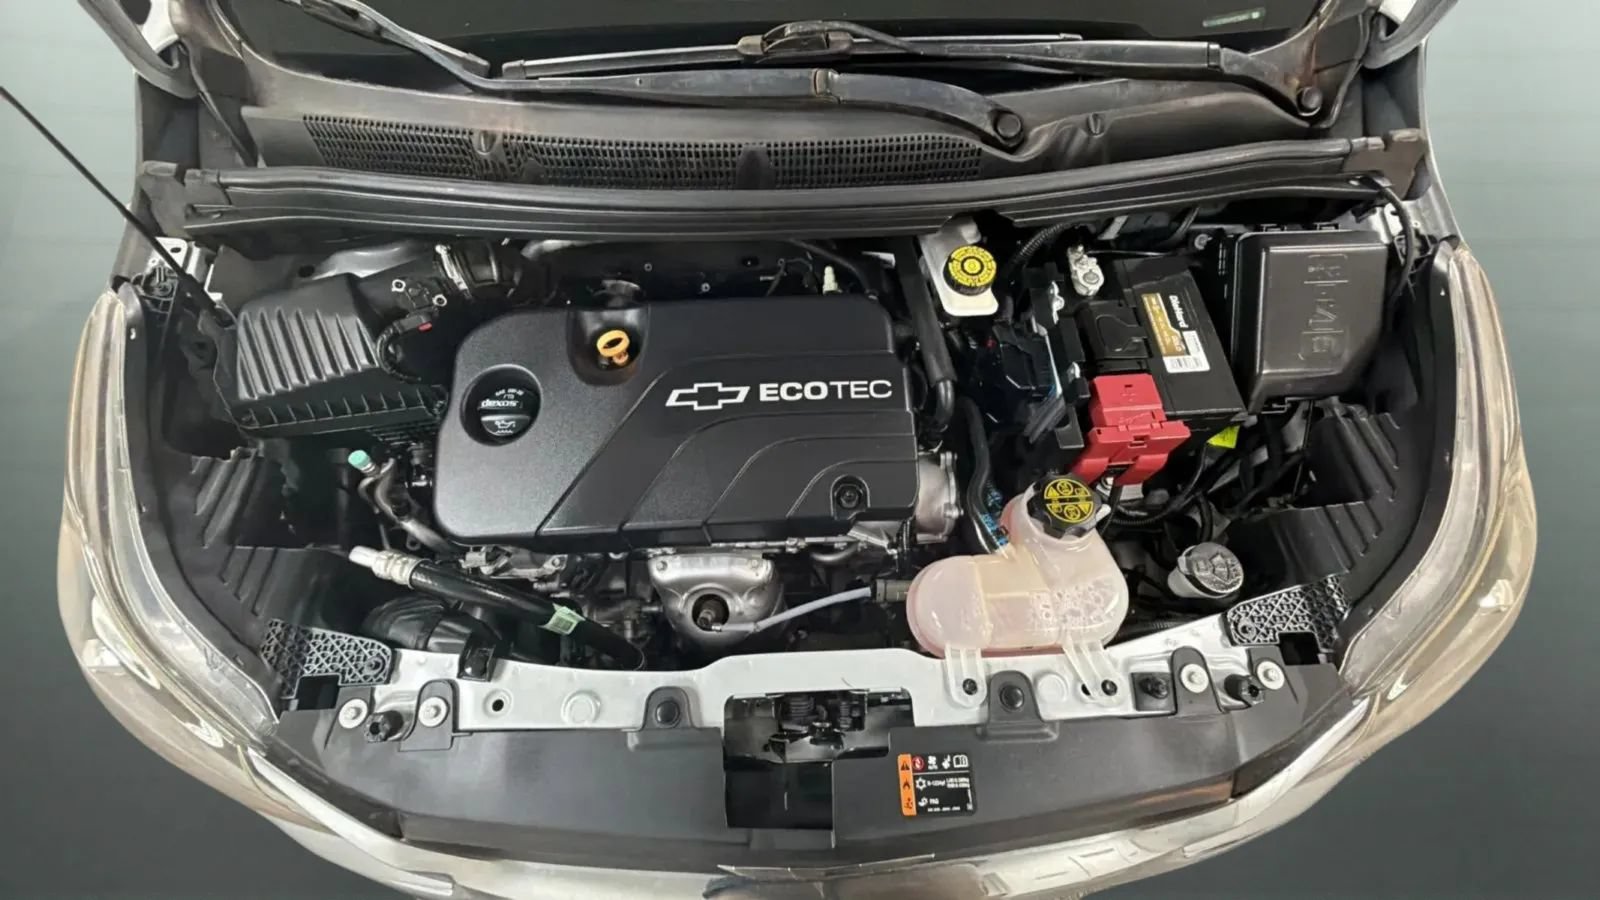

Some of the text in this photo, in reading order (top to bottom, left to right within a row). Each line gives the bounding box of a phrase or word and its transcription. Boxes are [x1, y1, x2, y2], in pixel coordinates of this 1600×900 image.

[1169, 295, 1189, 328] DieHard
[759, 380, 893, 402] ECOTEC
[481, 398, 517, 407] dexos
